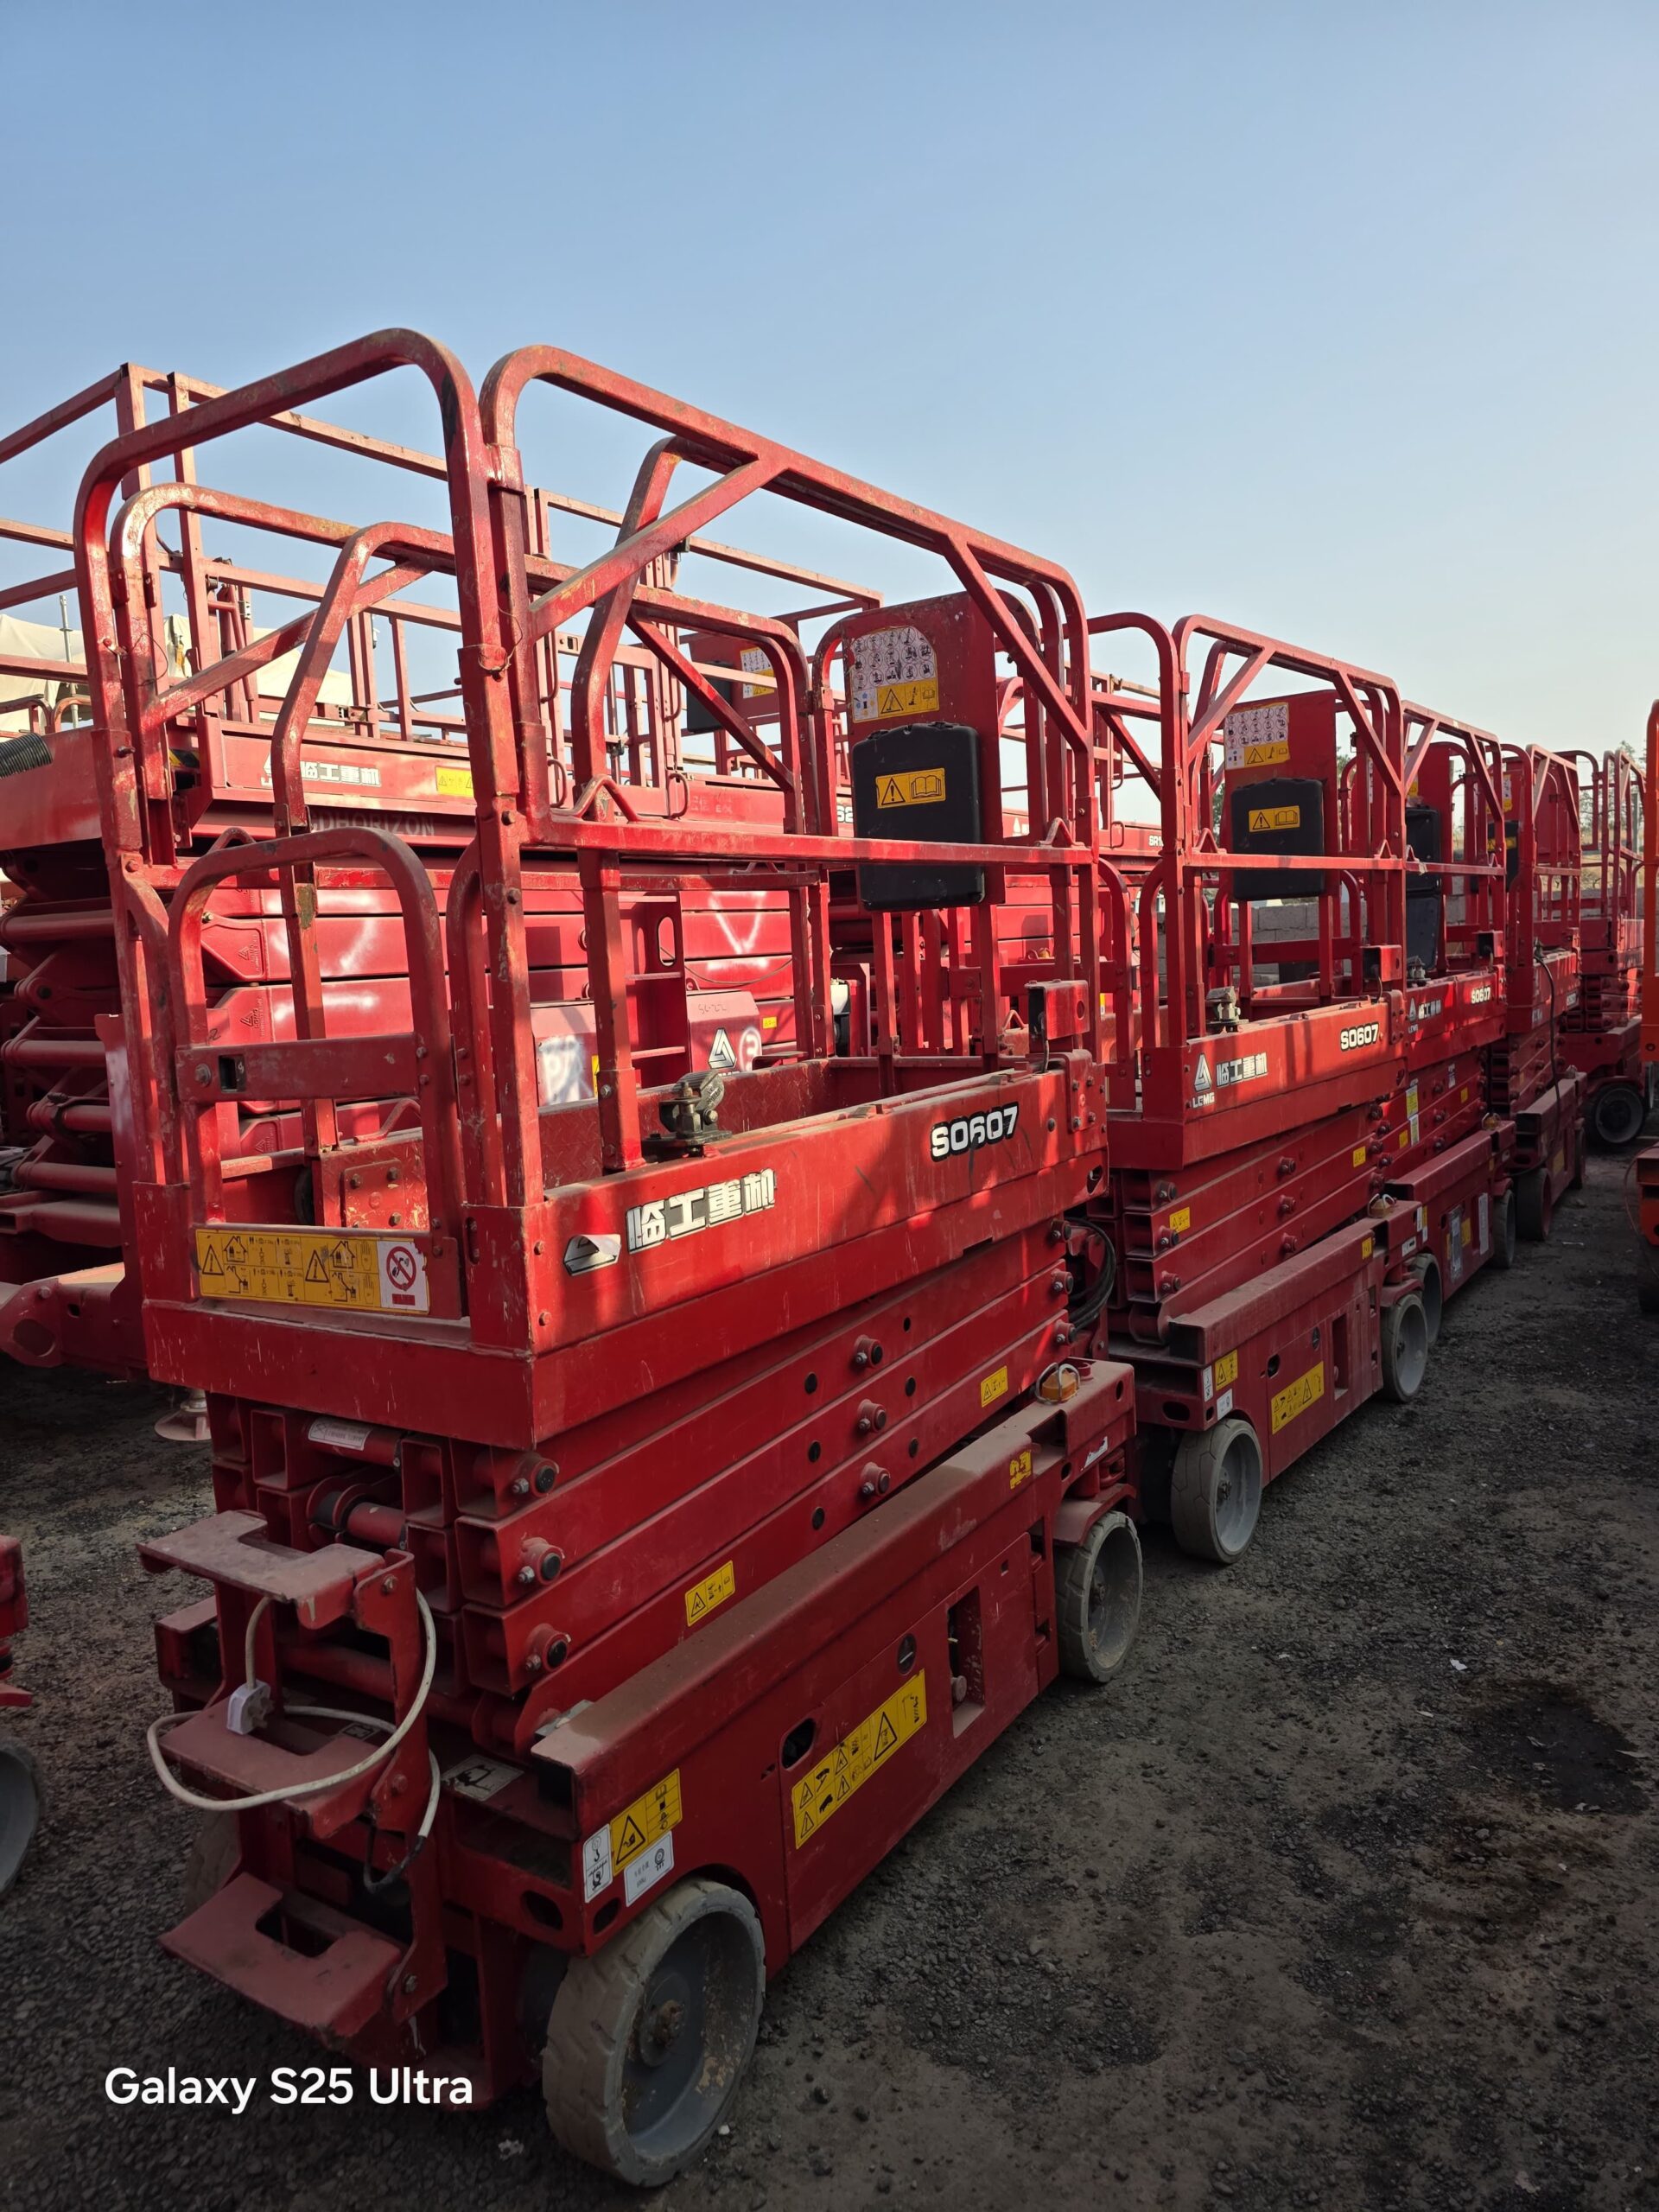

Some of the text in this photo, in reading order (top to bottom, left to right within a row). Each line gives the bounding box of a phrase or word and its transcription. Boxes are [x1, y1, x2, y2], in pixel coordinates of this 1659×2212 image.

[1217, 1052, 1268, 1086] 临工重机
[626, 1168, 775, 1253] 临工重机
